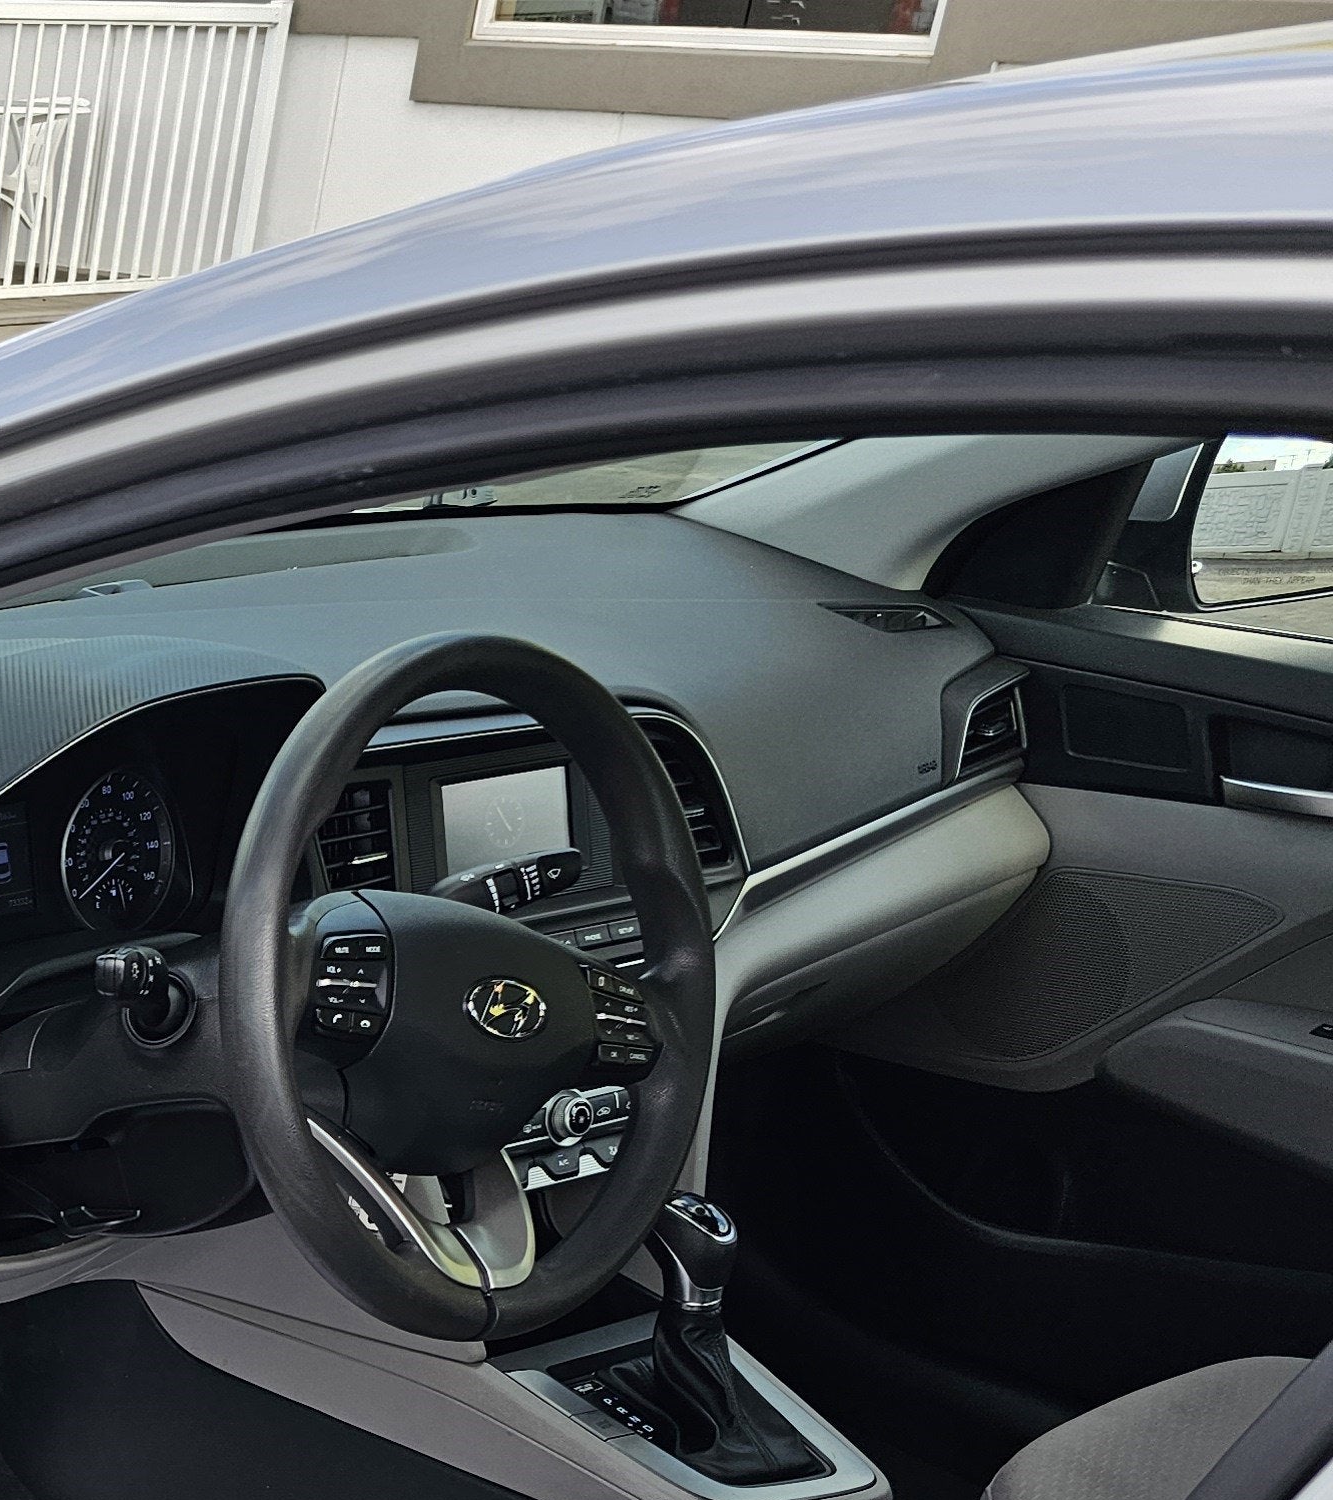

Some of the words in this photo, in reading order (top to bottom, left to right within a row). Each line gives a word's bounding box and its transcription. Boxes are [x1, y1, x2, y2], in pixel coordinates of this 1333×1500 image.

[102, 784, 112, 795] 80
[122, 791, 135, 801] 100
[139, 811, 152, 821] 120
[146, 839, 159, 850] 140
[143, 872, 156, 881] 160
[72, 888, 78, 898] 0
